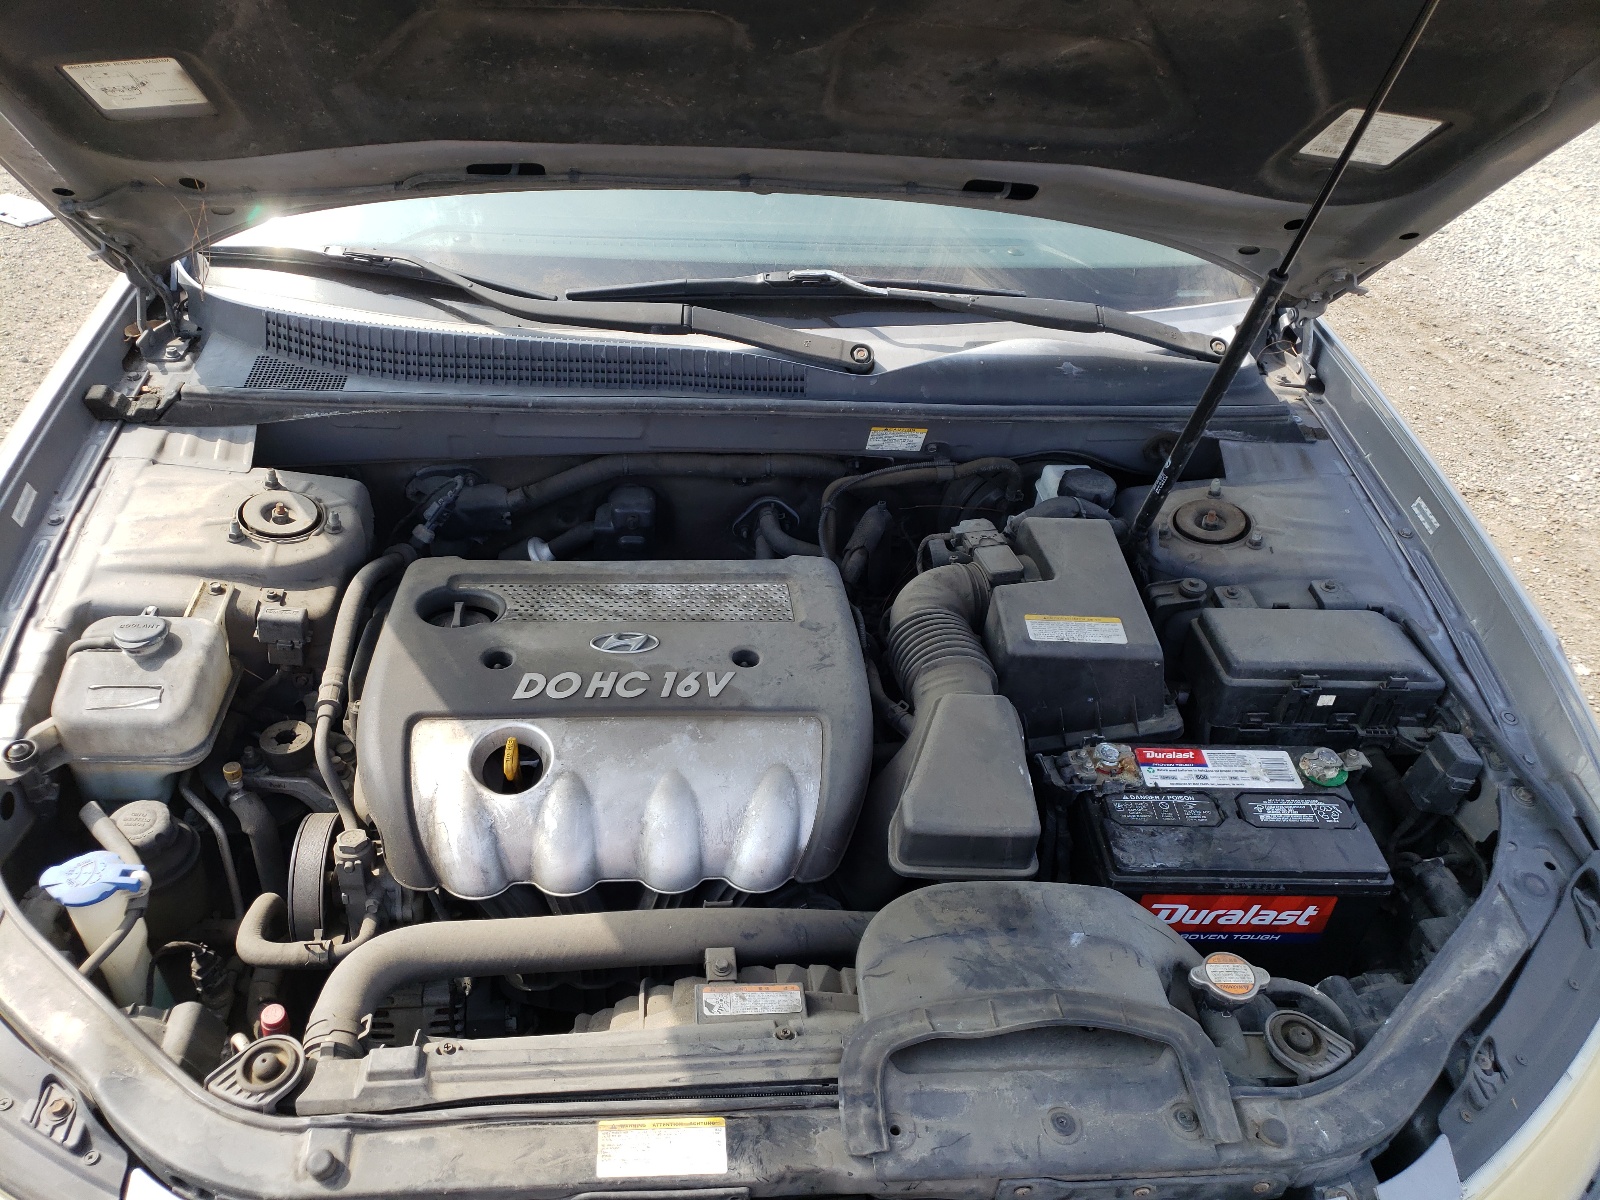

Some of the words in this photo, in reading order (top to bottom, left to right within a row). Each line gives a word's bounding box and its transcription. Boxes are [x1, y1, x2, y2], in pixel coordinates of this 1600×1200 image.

[512, 671, 651, 700] DOHC
[660, 671, 736, 698] 16V
[1143, 750, 1195, 759] Duralast
[1151, 903, 1320, 926] Duralast
